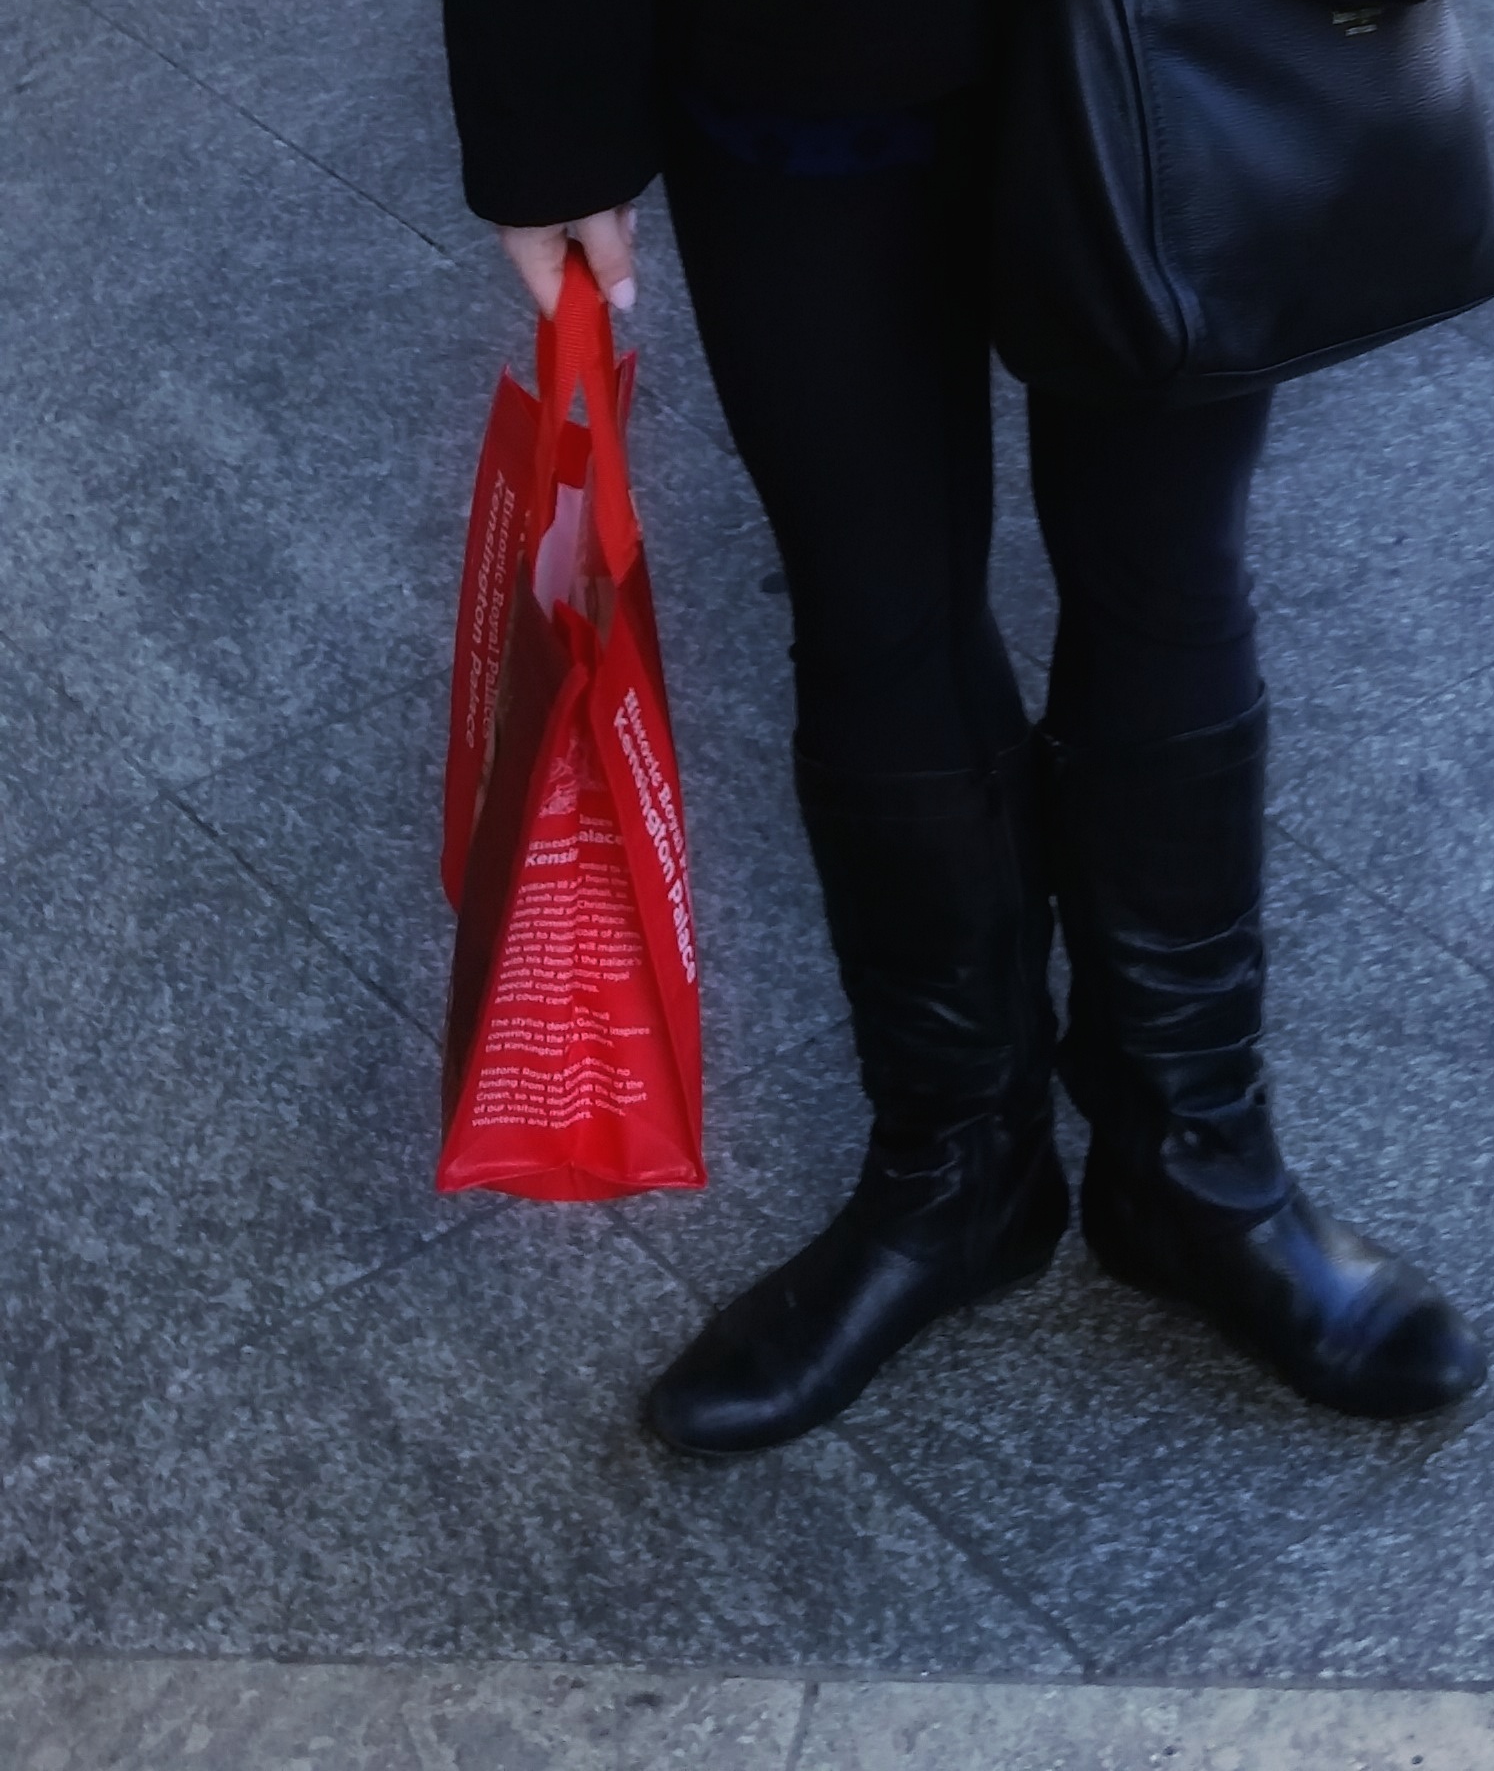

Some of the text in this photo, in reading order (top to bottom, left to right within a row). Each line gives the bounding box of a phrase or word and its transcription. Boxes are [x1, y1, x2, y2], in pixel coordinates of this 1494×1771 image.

[473, 470, 505, 643] Kensington
[614, 707, 675, 883] Kensington
[668, 879, 696, 984] Palace
